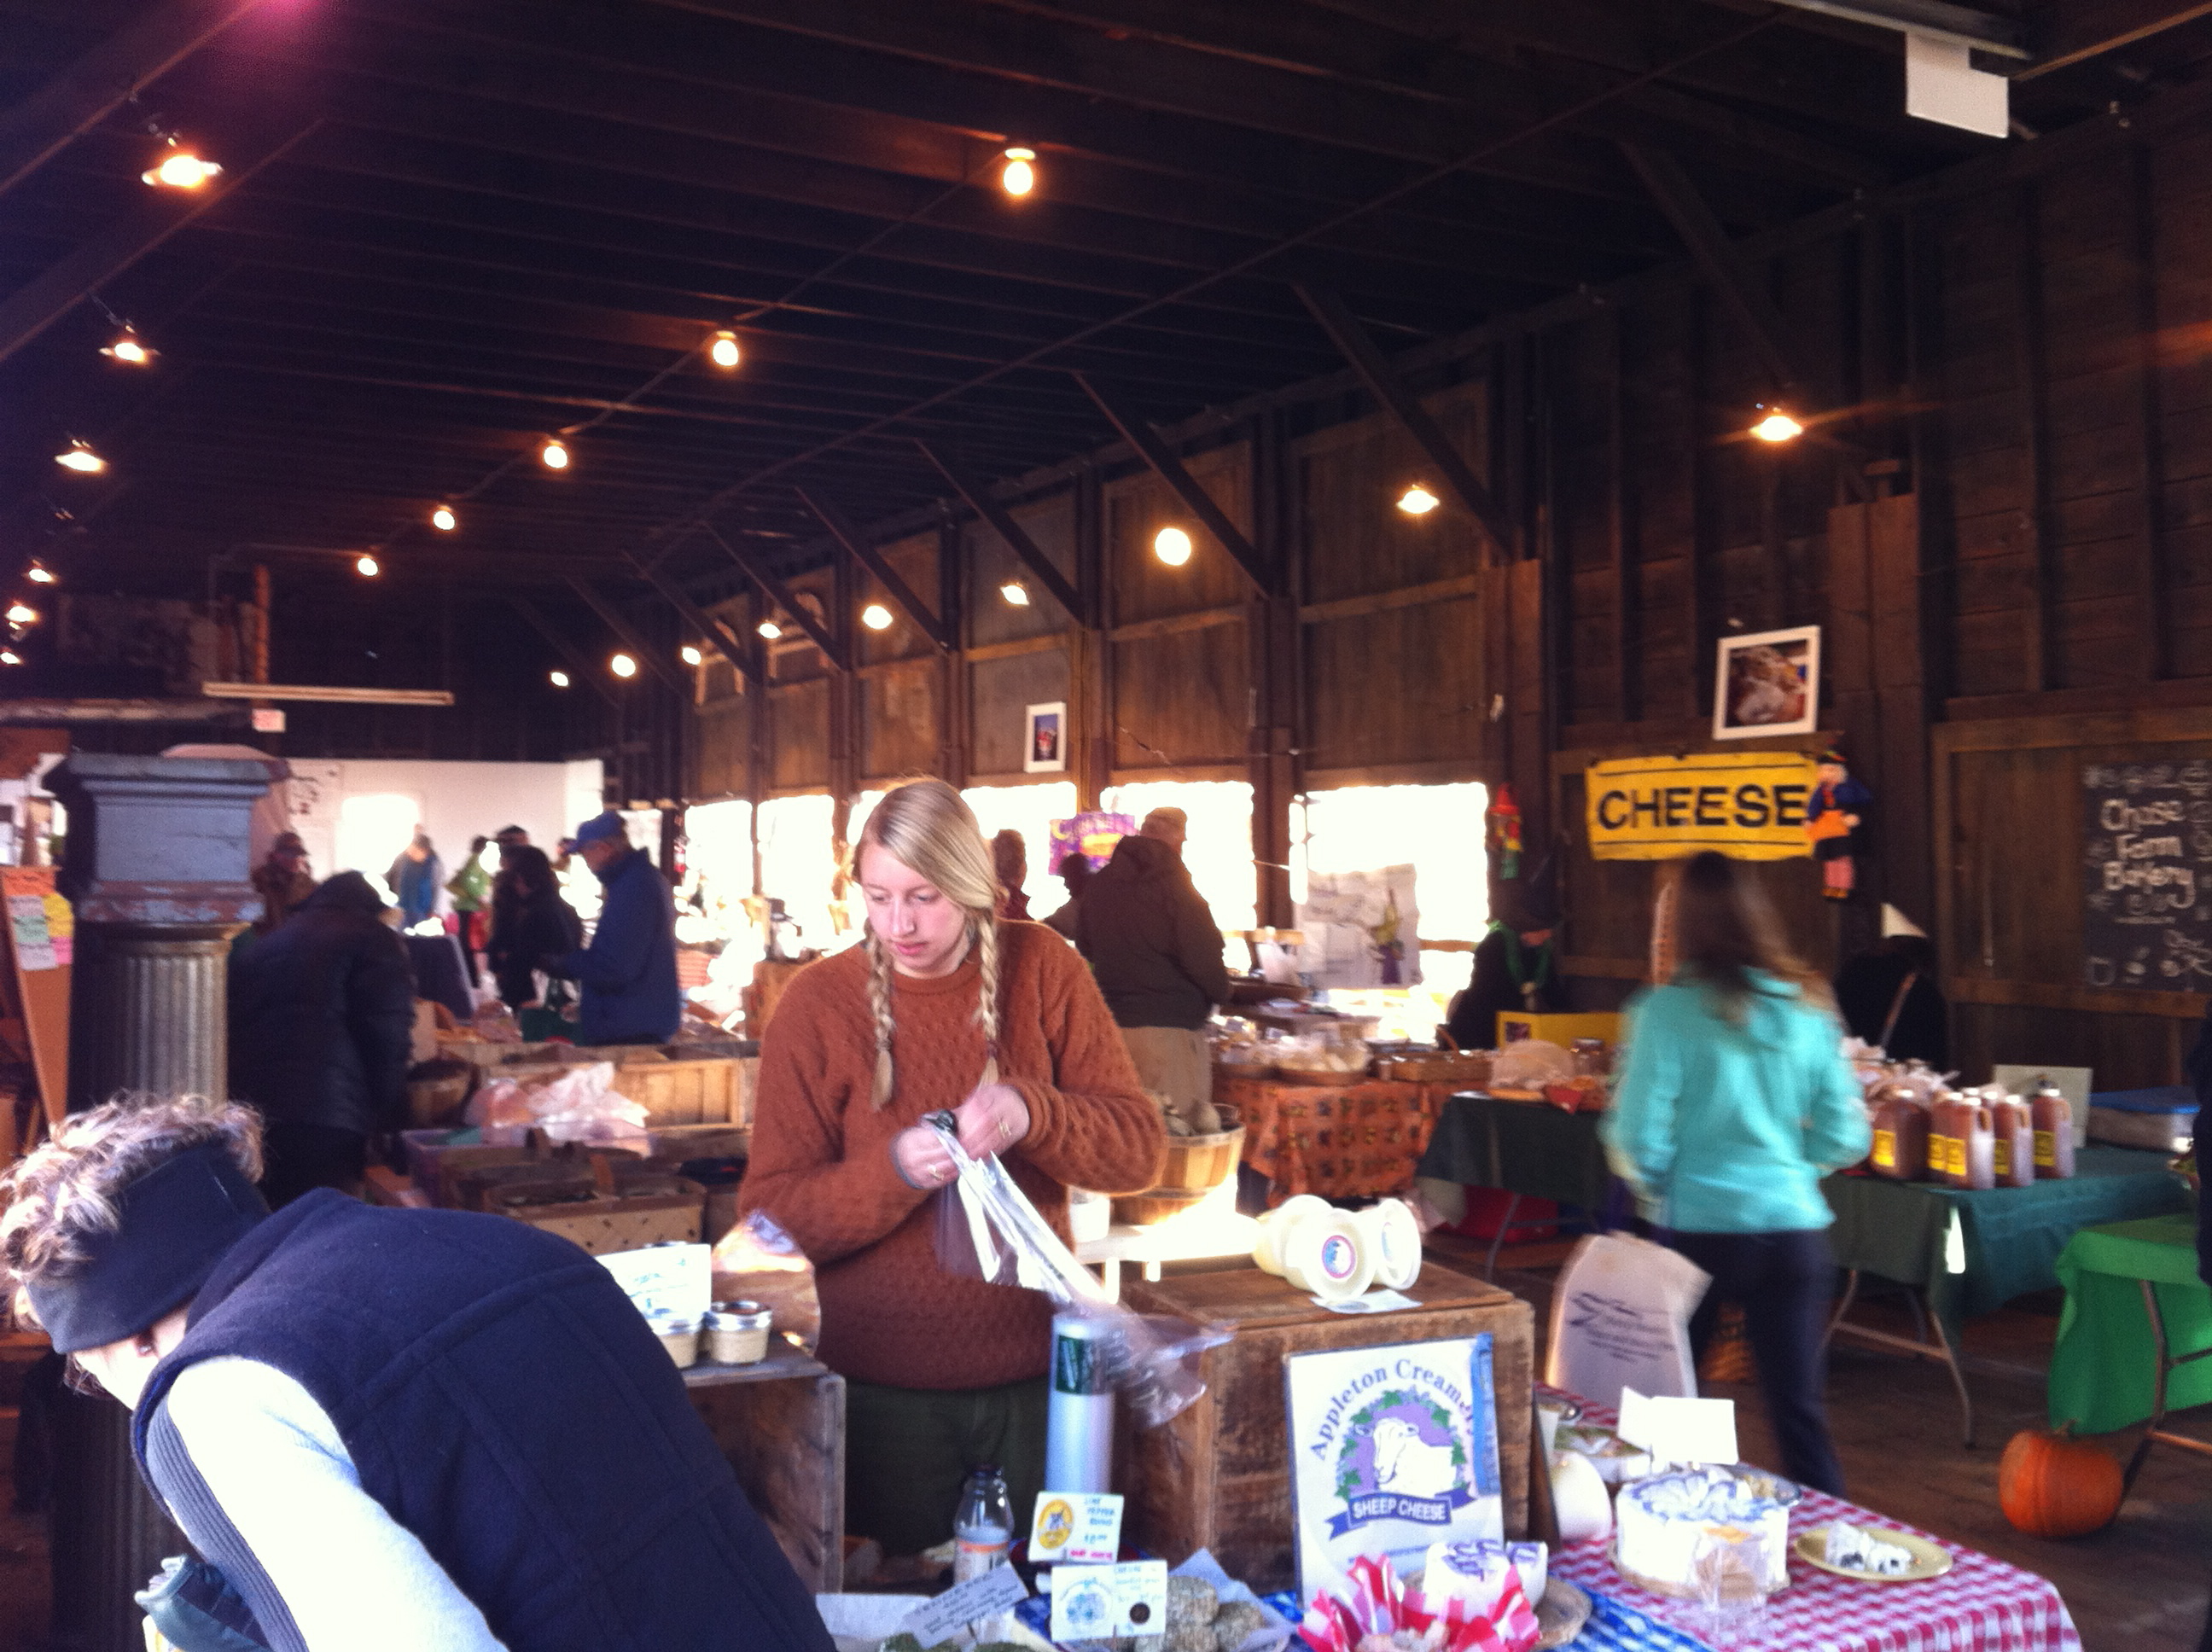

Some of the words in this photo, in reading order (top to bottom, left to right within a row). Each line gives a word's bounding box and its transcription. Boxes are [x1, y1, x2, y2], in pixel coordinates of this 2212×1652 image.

[1597, 783, 1807, 830] CHEESE
[1309, 1366, 1388, 1461] Appleton
[1352, 1497, 1397, 1520] SHEEP
[1397, 1498, 1447, 1521] CHEESE
